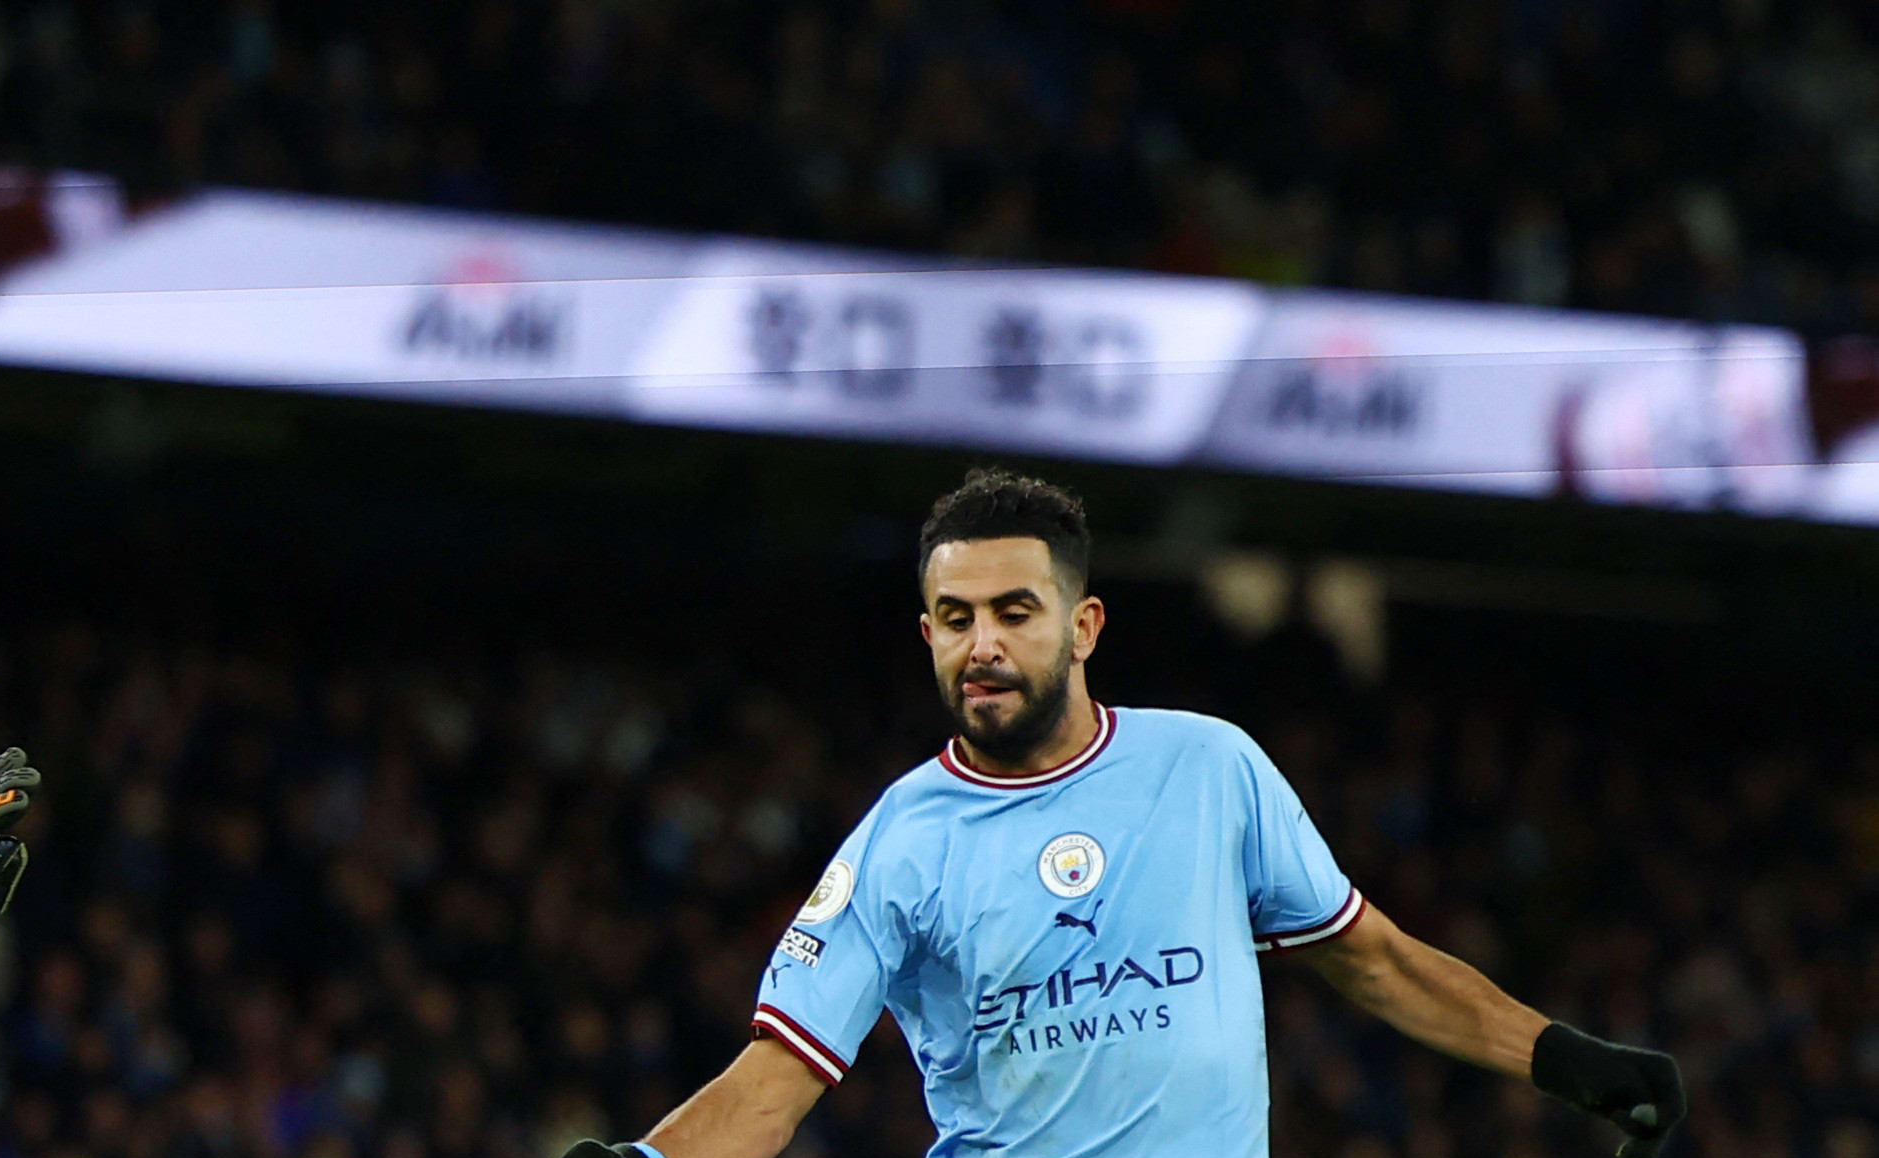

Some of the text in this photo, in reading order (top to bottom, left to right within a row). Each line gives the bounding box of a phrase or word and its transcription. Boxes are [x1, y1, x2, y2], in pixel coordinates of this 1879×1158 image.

[1043, 837, 1095, 864] MANCHESTER
[784, 928, 819, 954] oom
[974, 946, 1204, 1031] ETIHAD
[1009, 1004, 1171, 1055] AIRWAYS
